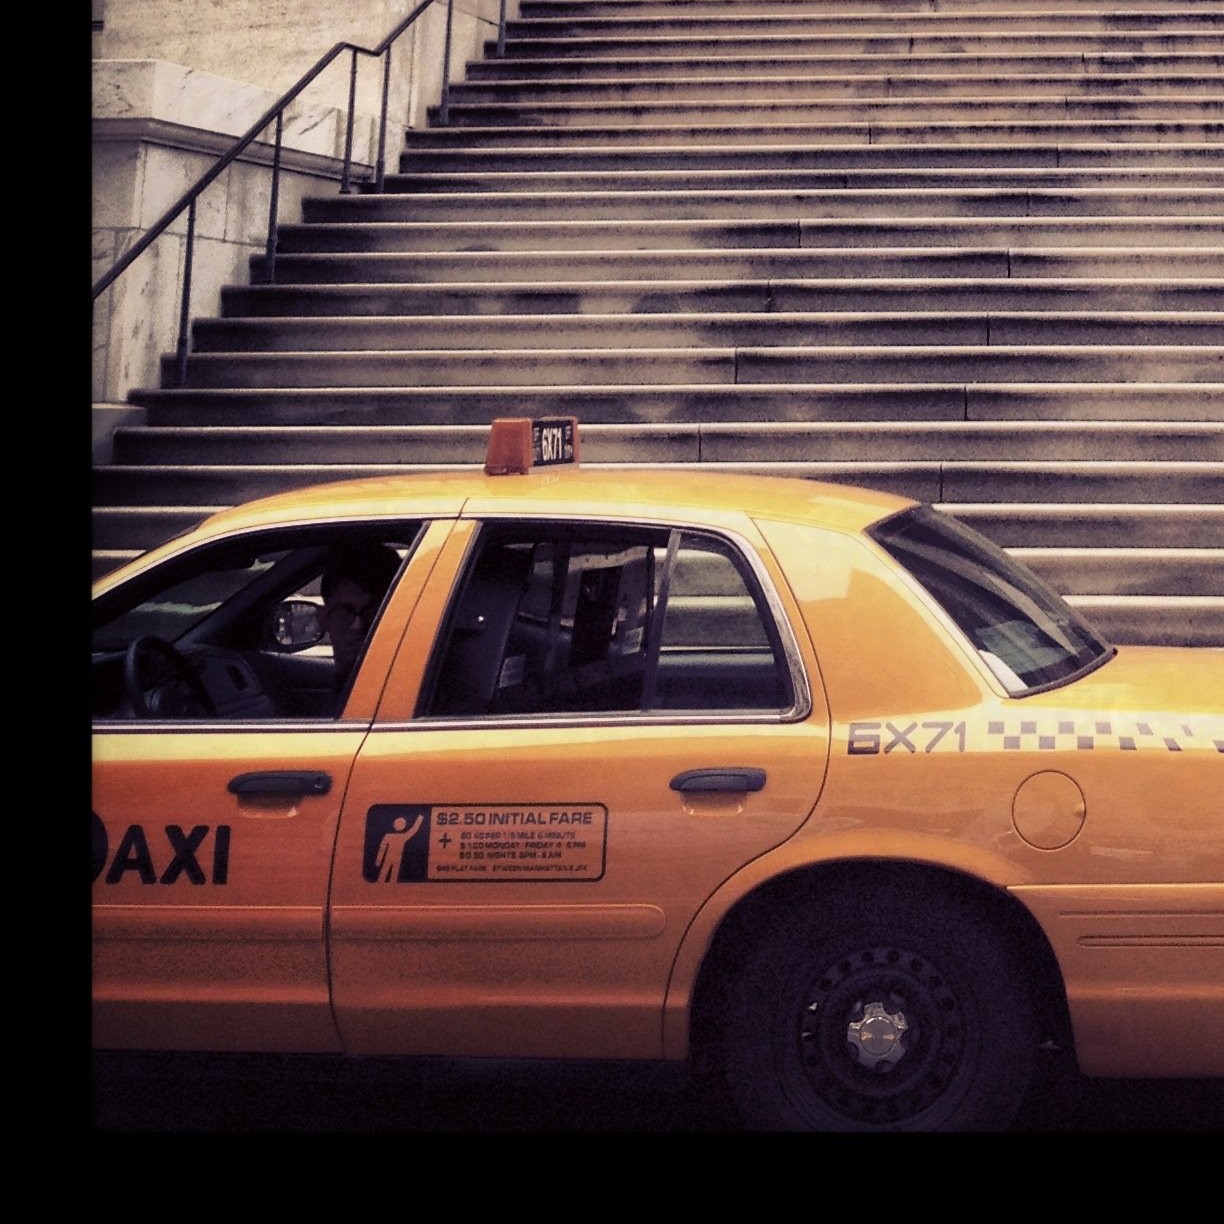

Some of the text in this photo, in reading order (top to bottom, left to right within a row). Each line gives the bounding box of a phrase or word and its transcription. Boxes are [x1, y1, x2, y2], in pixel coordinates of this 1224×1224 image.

[542, 427, 562, 461] 6X71
[848, 721, 966, 755] 6X71
[437, 812, 593, 826] $2.50 INITIAL FARE
